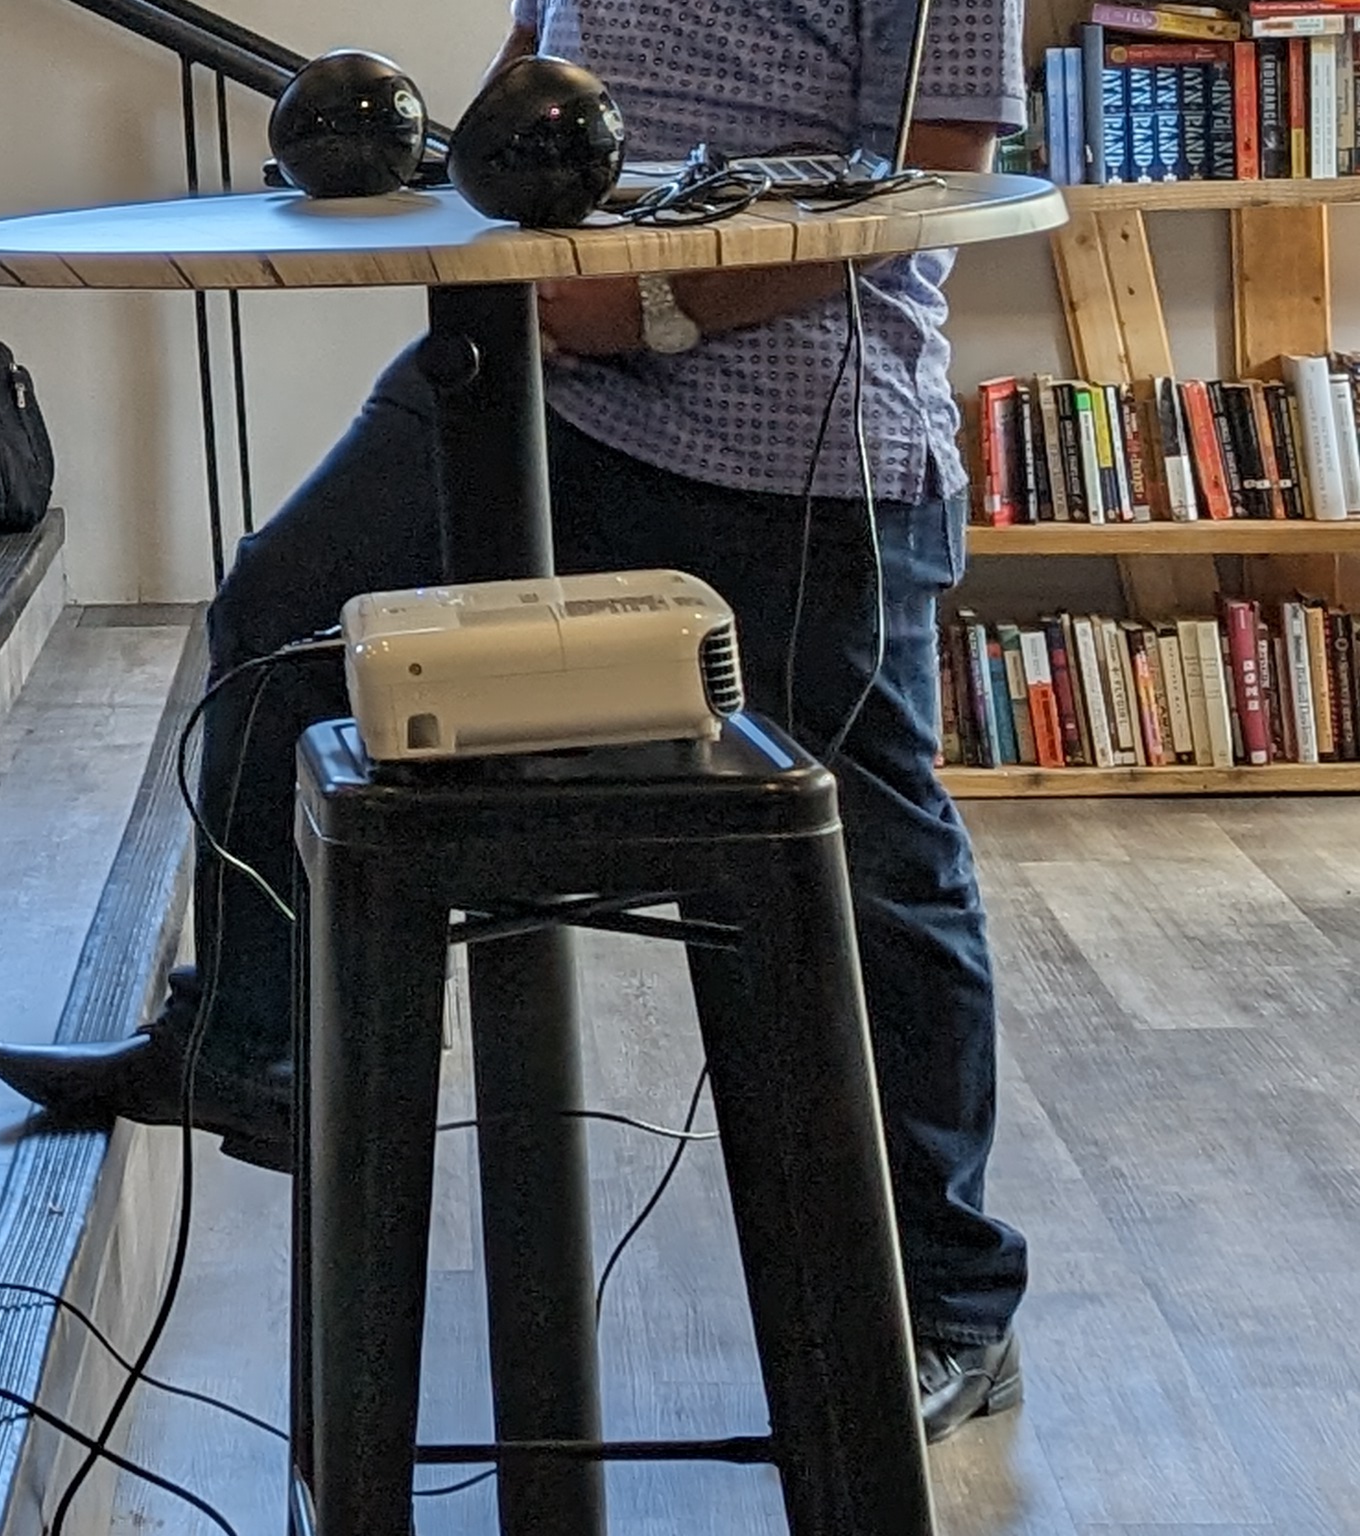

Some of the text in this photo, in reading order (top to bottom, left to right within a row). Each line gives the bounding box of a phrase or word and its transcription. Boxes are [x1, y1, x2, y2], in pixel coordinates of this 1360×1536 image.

[1101, 69, 1125, 167] AYN RAND
[1131, 67, 1154, 166] AYN RAND
[1156, 66, 1179, 165] AYN RAND
[1182, 66, 1205, 165] AYN RAND
[1211, 79, 1234, 178] AYN RAND
[1261, 54, 1278, 126] ENDURANCE
